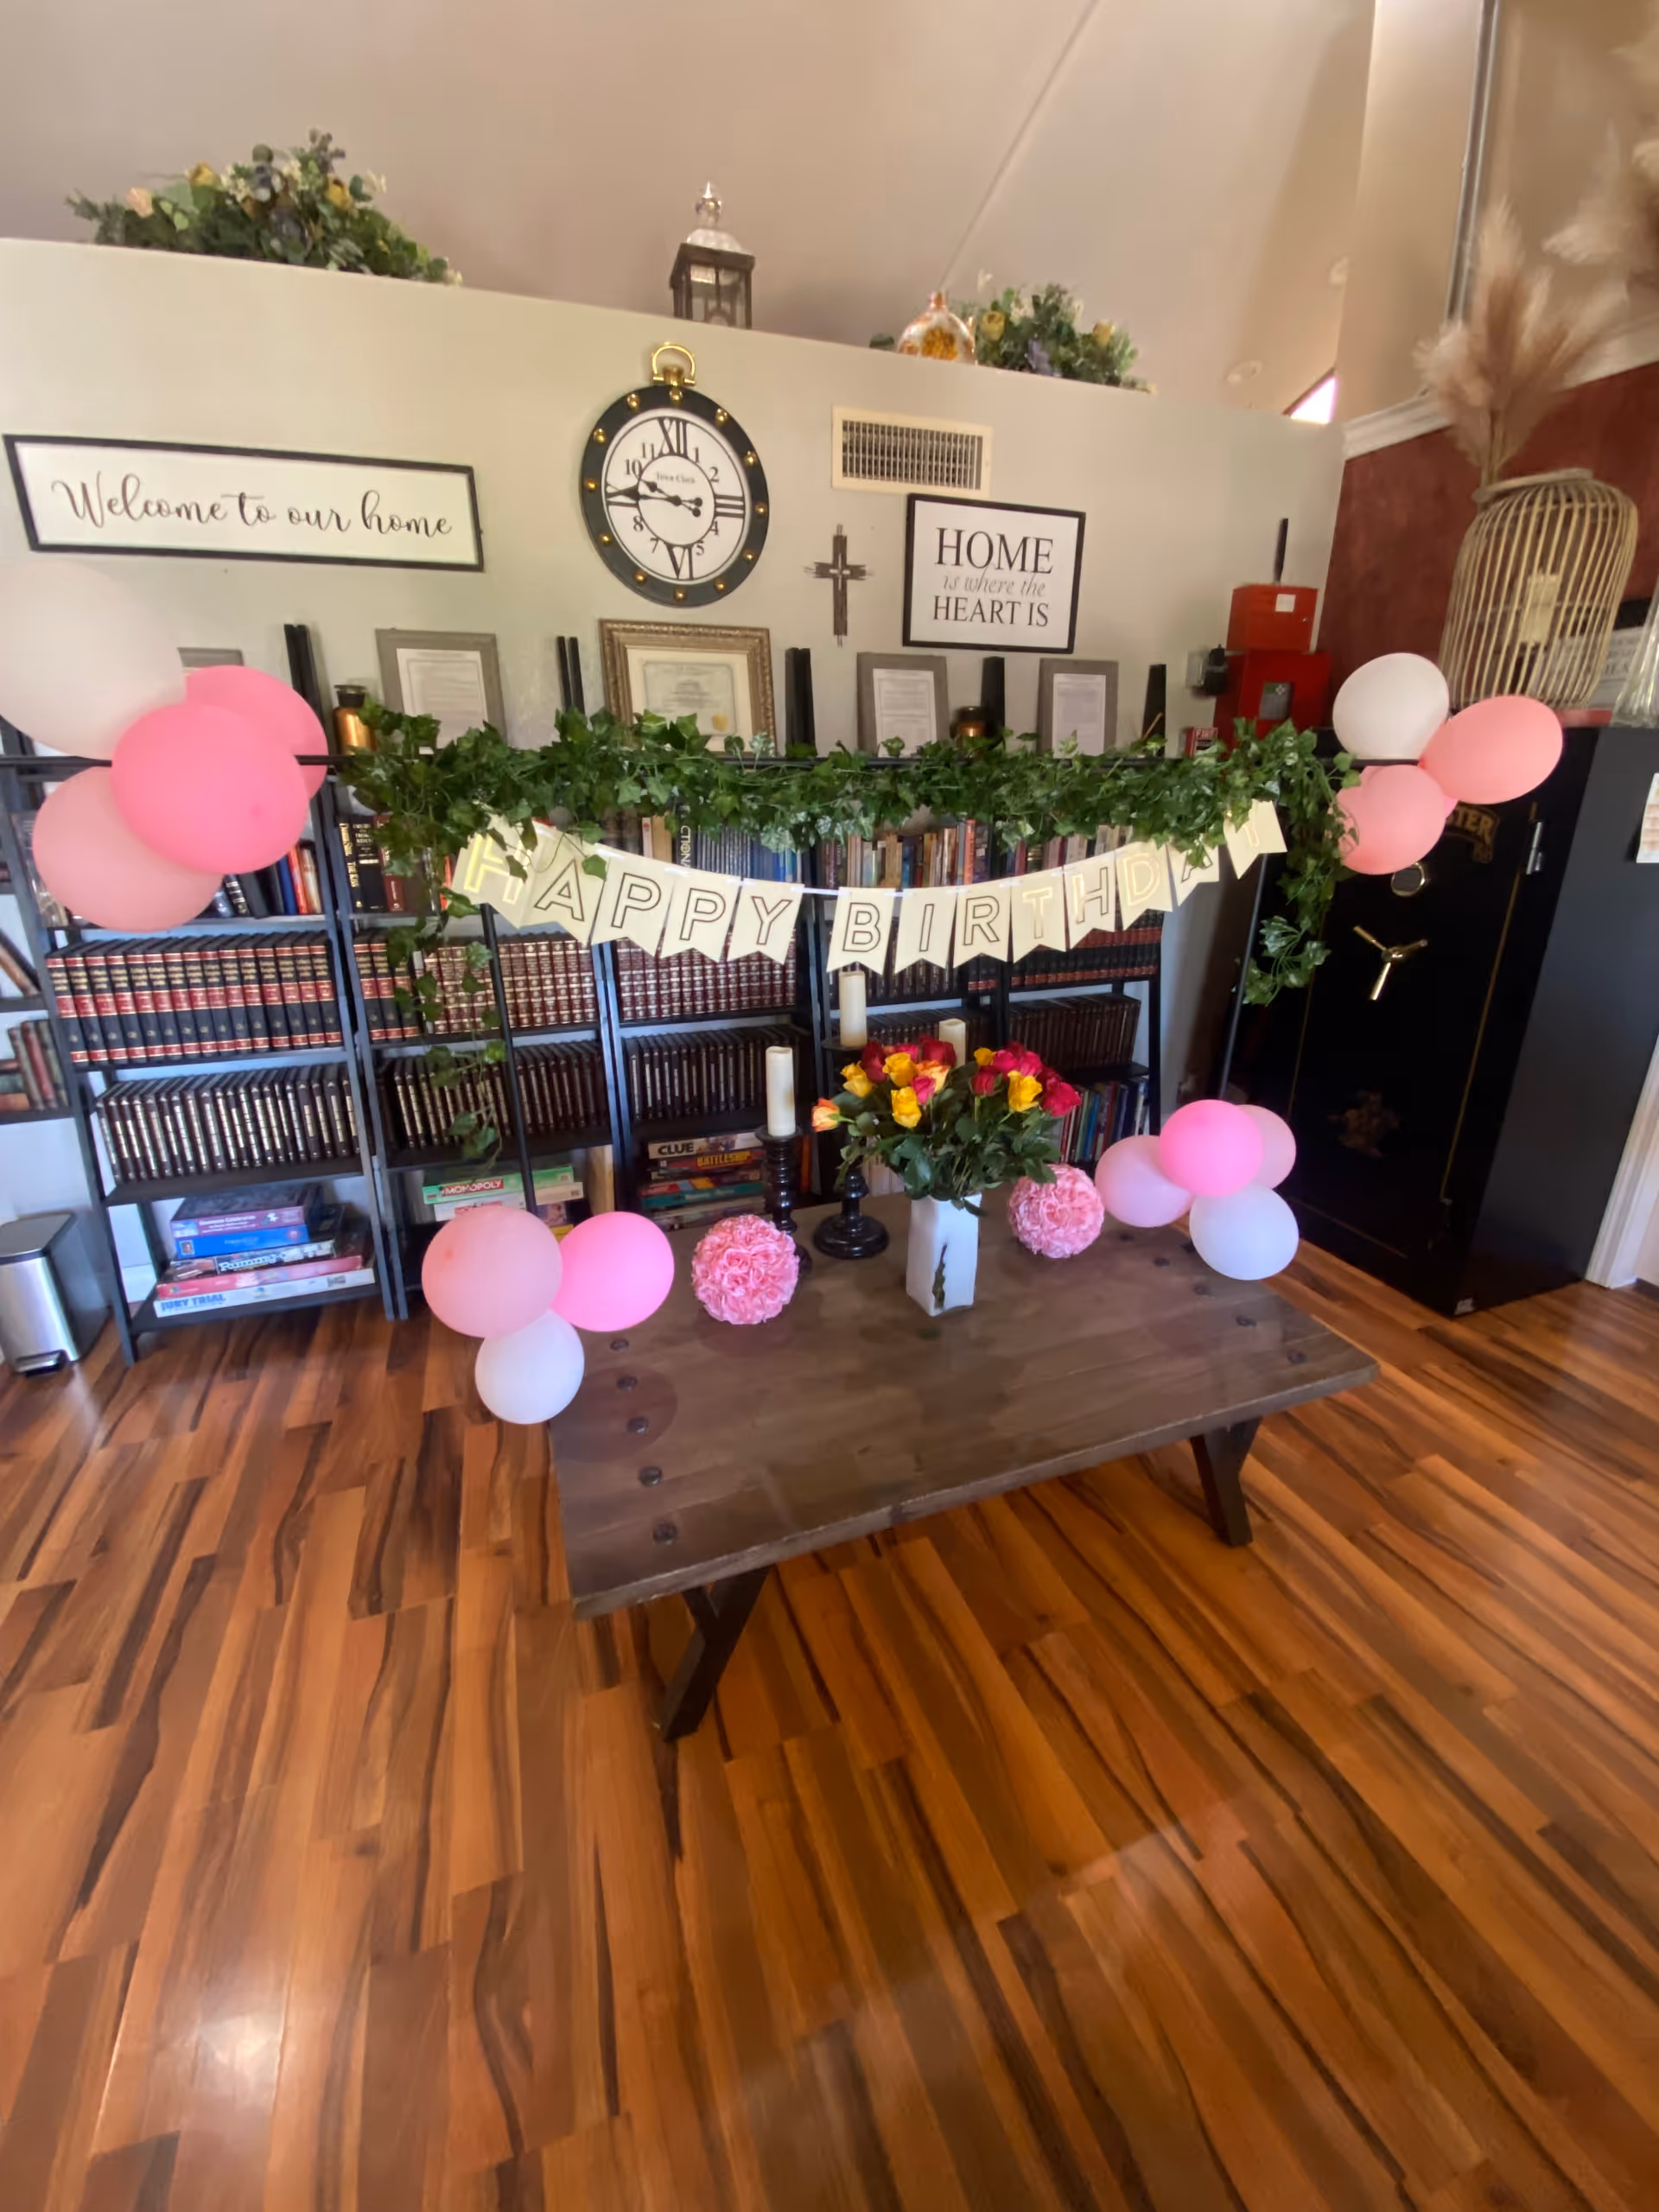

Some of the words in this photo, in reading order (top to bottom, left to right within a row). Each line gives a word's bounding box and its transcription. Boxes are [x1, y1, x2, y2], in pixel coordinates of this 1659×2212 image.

[657, 416, 690, 458] XII
[641, 442, 655, 461] 11
[693, 447, 701, 464] 1
[625, 459, 642, 476] 10
[709, 467, 720, 483] 2
[51, 471, 227, 528] Welcome
[220, 492, 276, 526] to
[287, 505, 351, 532] our
[361, 489, 452, 537] home
[632, 516, 645, 532] 8
[709, 521, 720, 536] 4
[650, 537, 660, 554] 7
[695, 539, 705, 556] 5
[934, 527, 1053, 574] HOME
[943, 575, 960, 590] is
[964, 567, 1014, 594] where
[1020, 571, 1046, 598] the
[933, 594, 1021, 625] HEART
[1027, 601, 1049, 627] IS
[658, 1142, 694, 1155] CLUE
